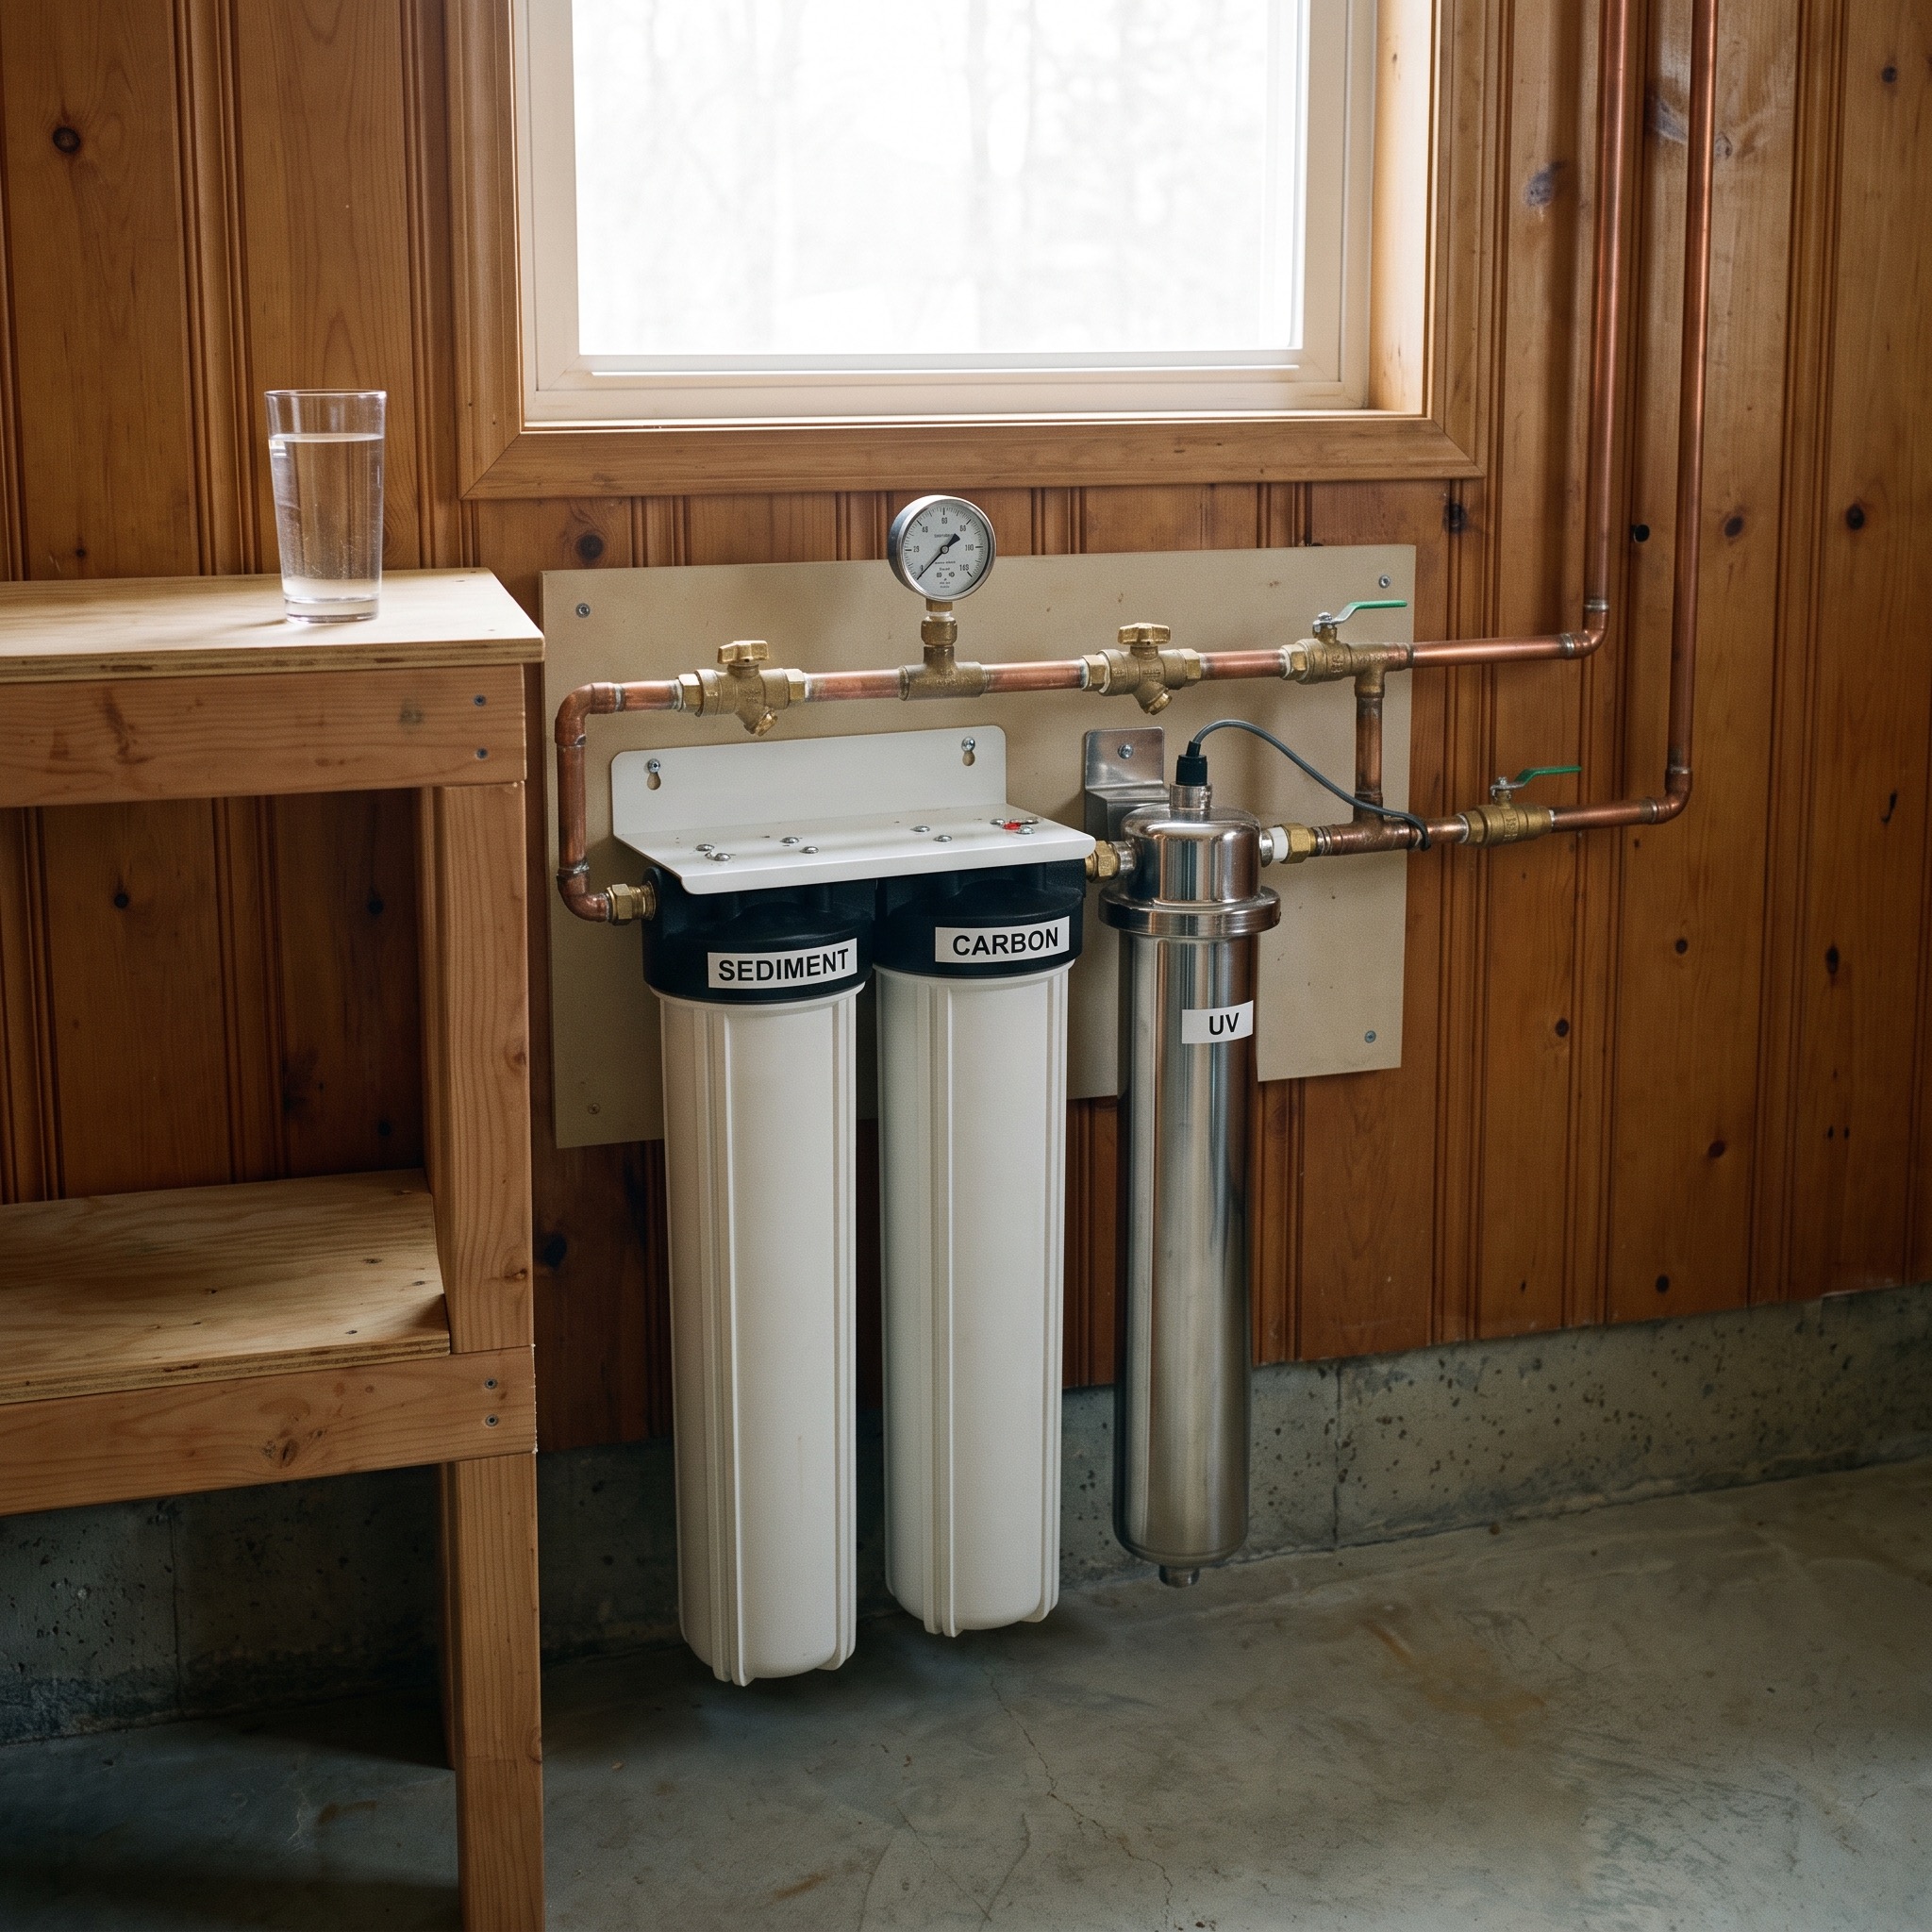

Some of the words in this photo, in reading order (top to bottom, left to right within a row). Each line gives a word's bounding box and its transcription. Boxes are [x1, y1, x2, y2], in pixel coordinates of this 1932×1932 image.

[953, 926, 1058, 956] CARBON
[718, 948, 849, 981] SEDIMENT
[1209, 1012, 1240, 1035] UV
